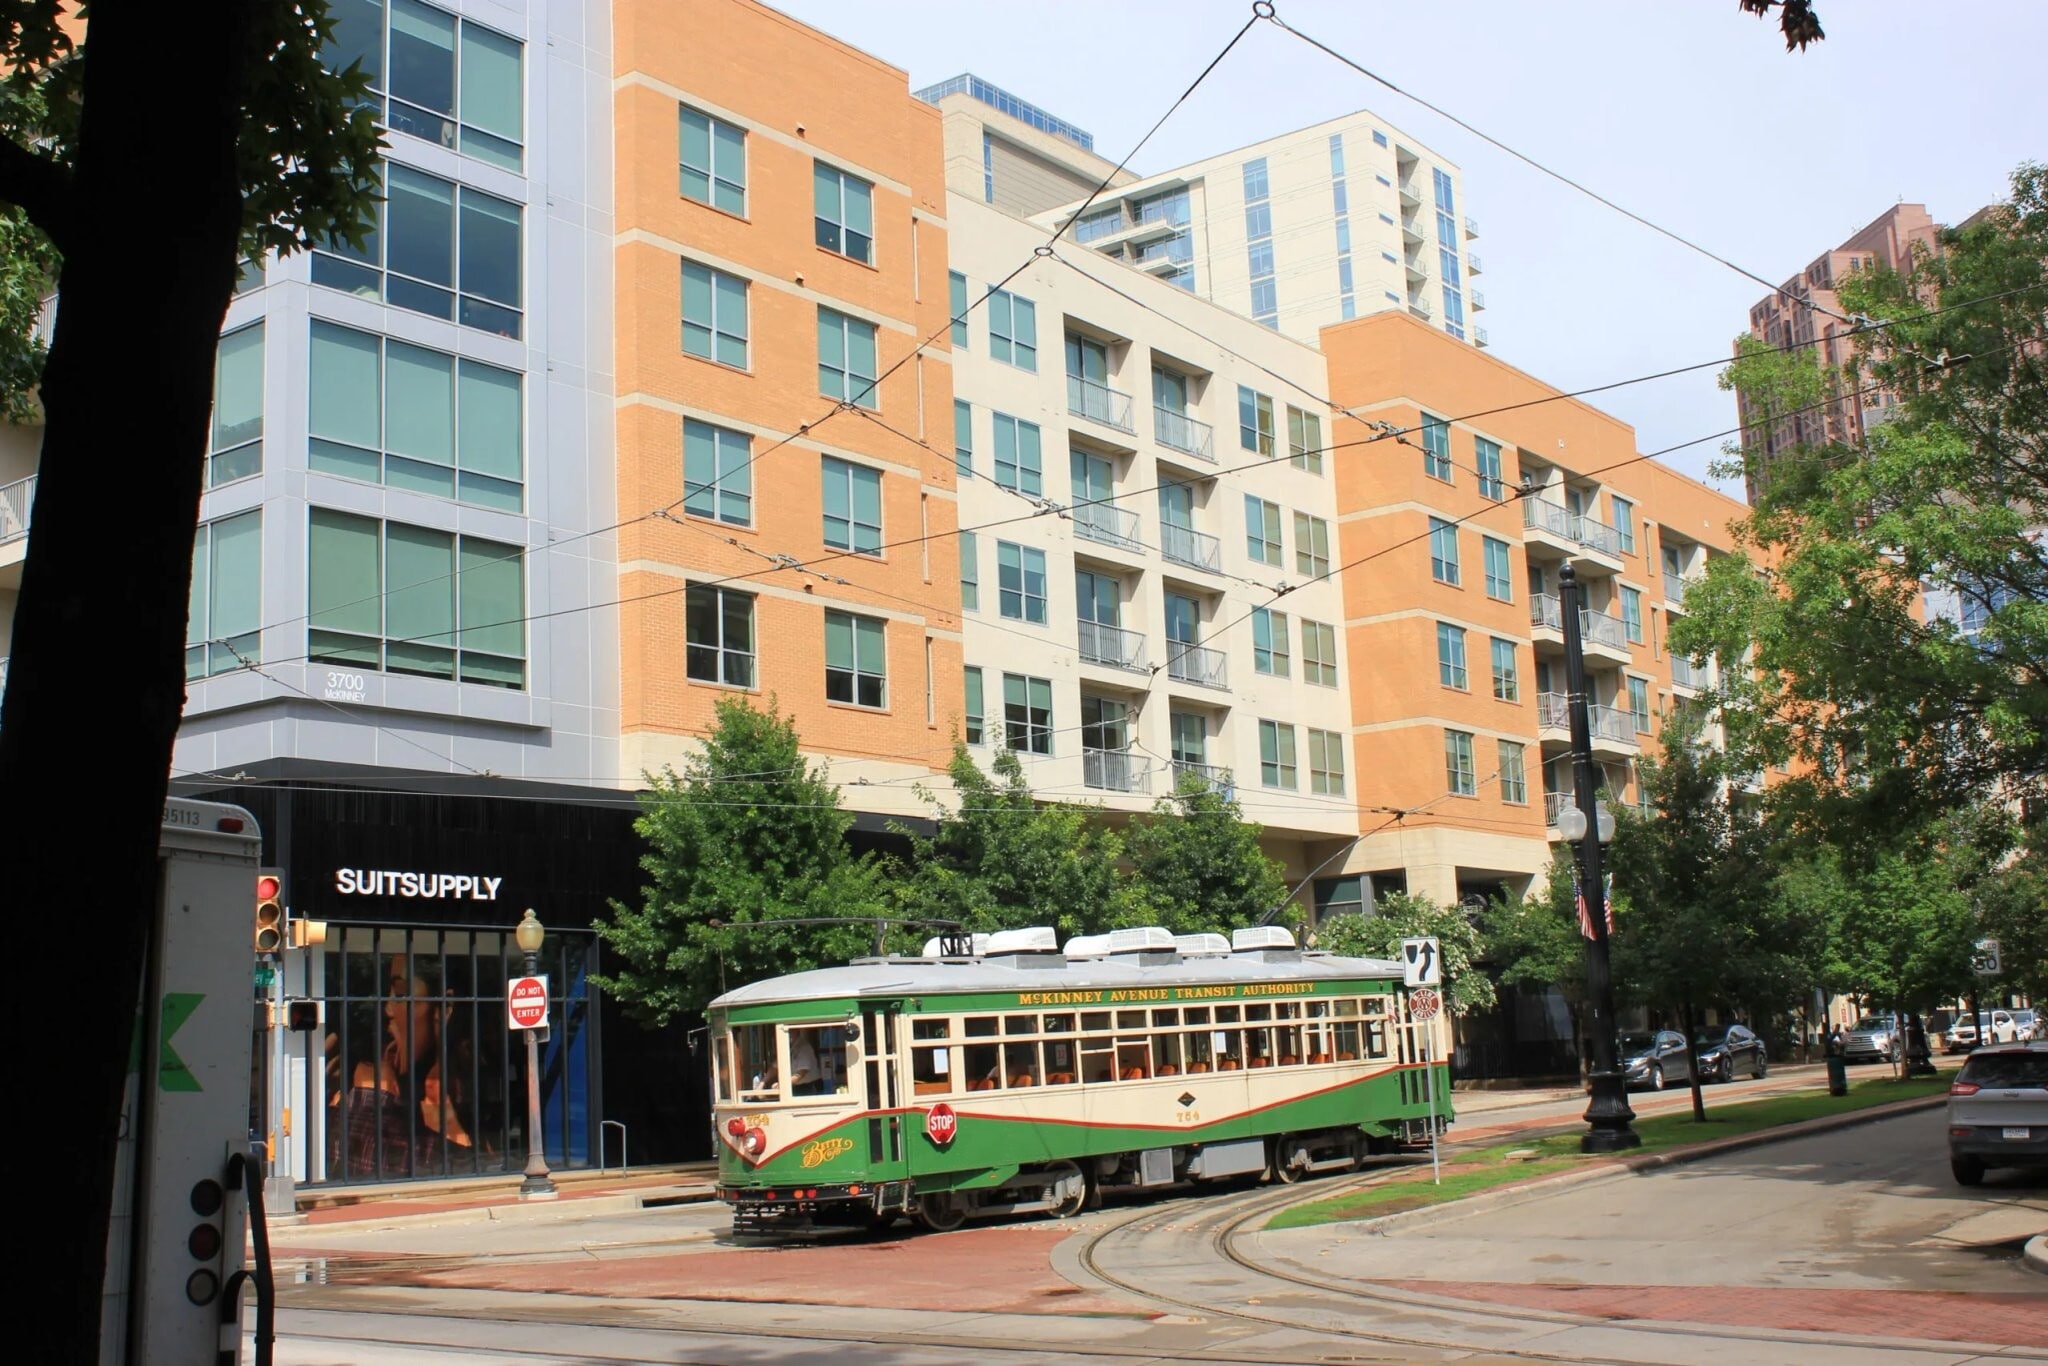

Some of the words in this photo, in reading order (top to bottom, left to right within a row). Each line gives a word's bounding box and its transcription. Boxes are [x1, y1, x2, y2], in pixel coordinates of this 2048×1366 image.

[327, 672, 364, 691] 3700
[336, 868, 502, 900] SUITSUPPLY
[516, 988, 526, 997] DO
[528, 986, 541, 996] NOT
[1110, 988, 1168, 1001] AVENUE
[1175, 985, 1236, 999] TRANSIT
[1242, 982, 1315, 996] AUTHORITY
[516, 1008, 540, 1018] ENTER
[930, 1114, 954, 1131] STOP
[1176, 1110, 1200, 1122] 754
